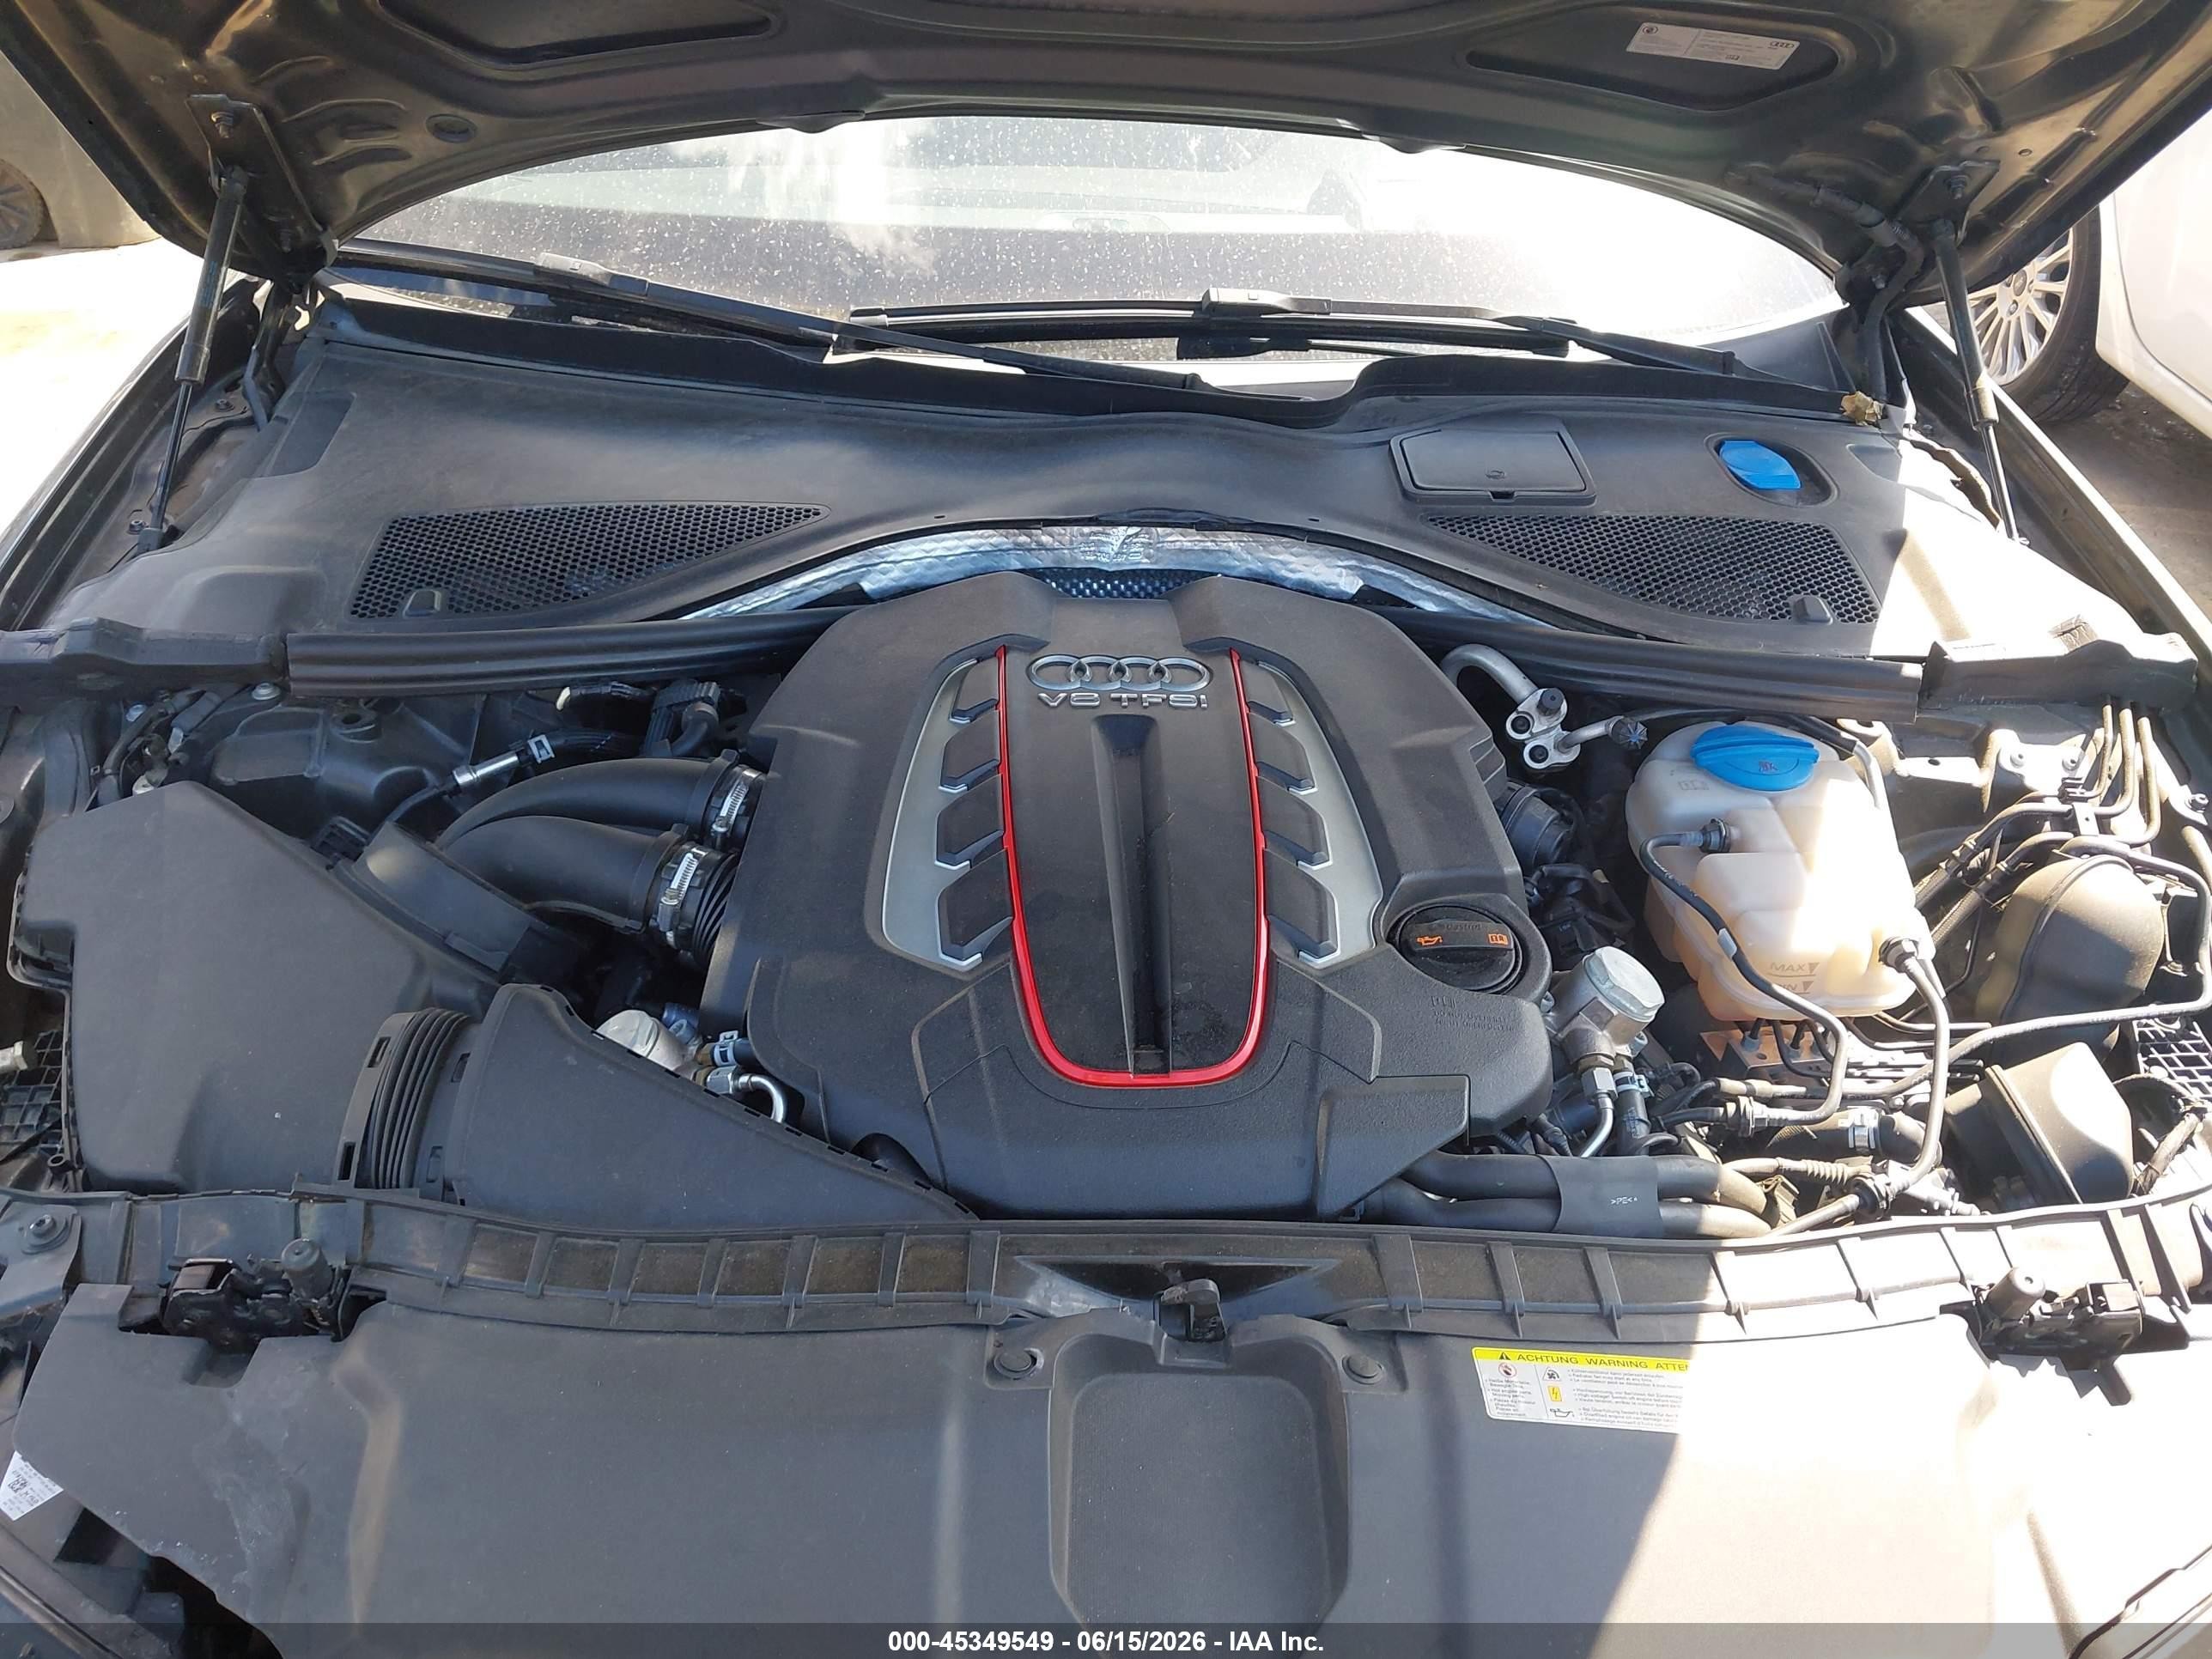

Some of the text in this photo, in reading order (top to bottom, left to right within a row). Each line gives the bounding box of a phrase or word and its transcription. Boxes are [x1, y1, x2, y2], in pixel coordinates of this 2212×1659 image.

[1770, 962, 1805, 972] MAX
[1516, 1353, 1579, 1364] ACHTUNG
[1585, 1358, 1649, 1369] WARNING
